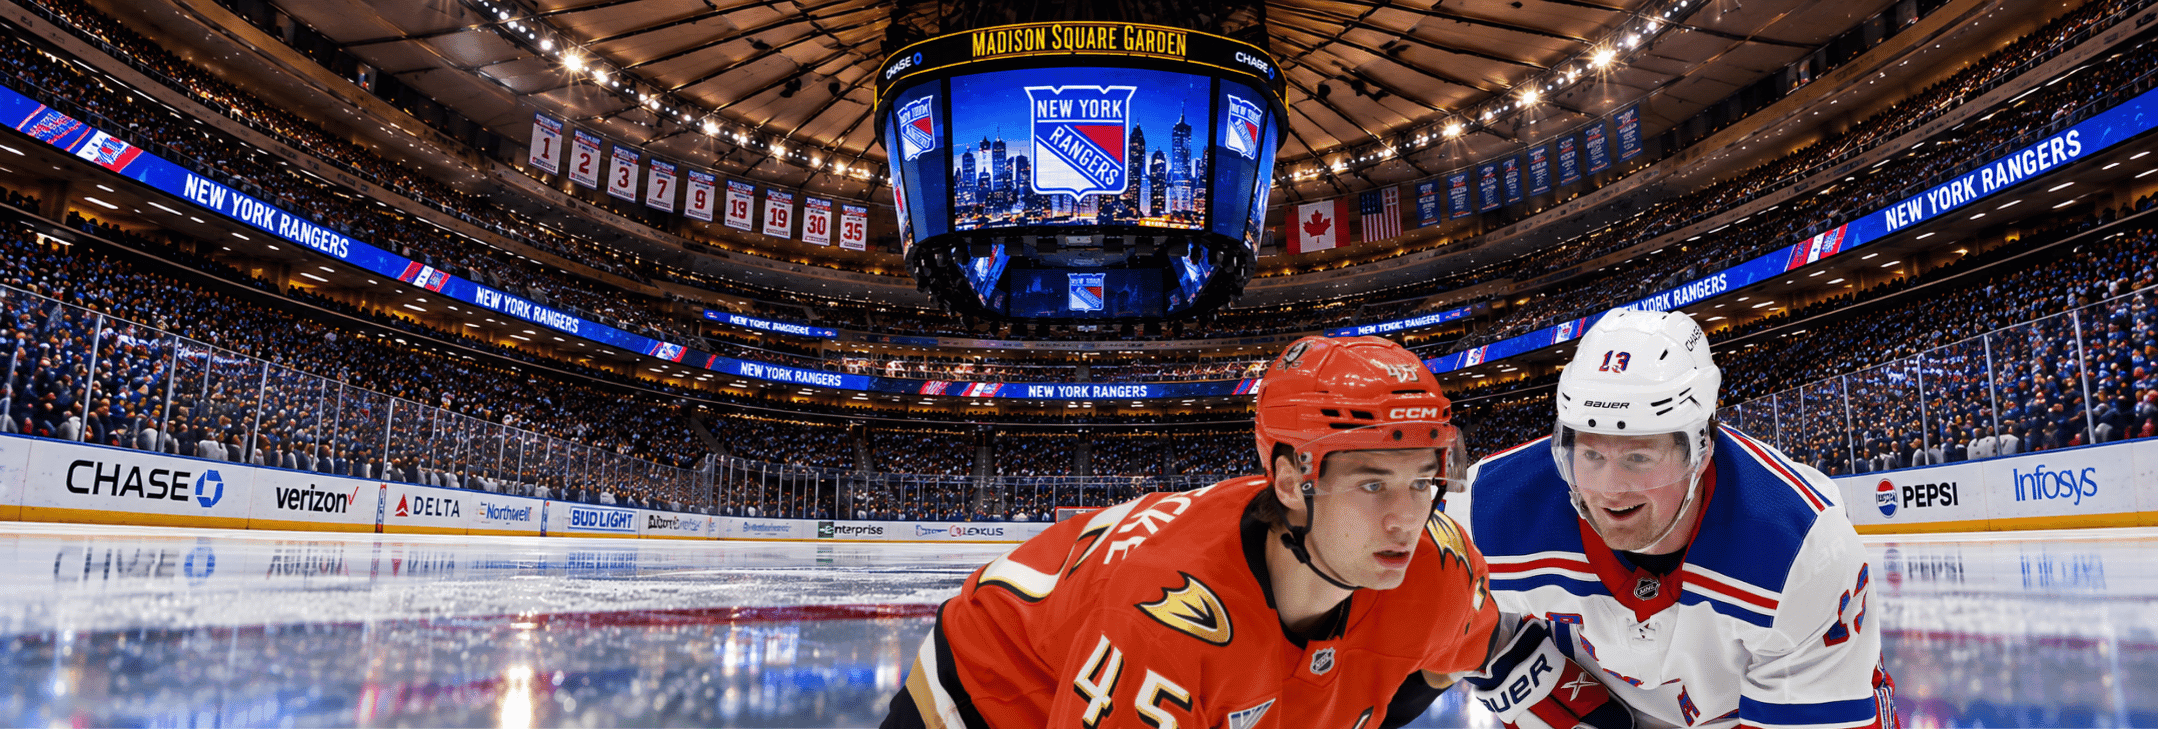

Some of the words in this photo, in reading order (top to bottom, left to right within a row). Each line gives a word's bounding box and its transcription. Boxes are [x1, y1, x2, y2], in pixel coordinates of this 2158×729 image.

[972, 28, 1045, 57] MADISON
[1052, 23, 1117, 52] SQUARE
[1124, 24, 1187, 57] GARDEN
[1037, 99, 1073, 118] NEW
[1079, 99, 1122, 118] YORK
[541, 137, 551, 160] 1
[1049, 126, 1119, 186] RANGERS
[578, 152, 592, 175] 2
[617, 166, 630, 189] 3
[656, 178, 668, 199] 7
[1885, 197, 1923, 233] NEW
[1927, 174, 1977, 215] YORK
[1981, 129, 2082, 194] RANGERS
[694, 188, 706, 210] 9
[183, 173, 227, 211] NEW
[231, 192, 277, 232] YORK
[278, 213, 350, 259] RANGERS
[768, 207, 788, 228] 19
[807, 214, 827, 236] 30
[843, 221, 863, 242] 35
[1641, 293, 1671, 312] YORK
[1673, 273, 1727, 307] RANGERS
[475, 286, 502, 310] NEW
[504, 295, 532, 320] YORK
[533, 306, 580, 334] RANGERS
[1598, 350, 1631, 374] 13
[740, 362, 763, 378] NEW
[765, 366, 793, 382] YORK
[795, 371, 842, 387] RANGERS
[1028, 385, 1057, 398] NEW
[1058, 385, 1090, 398] YORK
[1092, 385, 1148, 398] RANGERS
[1389, 408, 1438, 419] CCM
[65, 459, 191, 502] CHASE
[2013, 464, 2098, 505] Infosys
[276, 484, 348, 513] verizon
[413, 495, 461, 518] DELTA
[1902, 482, 1959, 509] PEPSI
[486, 502, 532, 522] Northwell
[572, 509, 598, 527] BUD
[599, 510, 633, 529] LIGHT
[1073, 633, 1194, 729] 45
